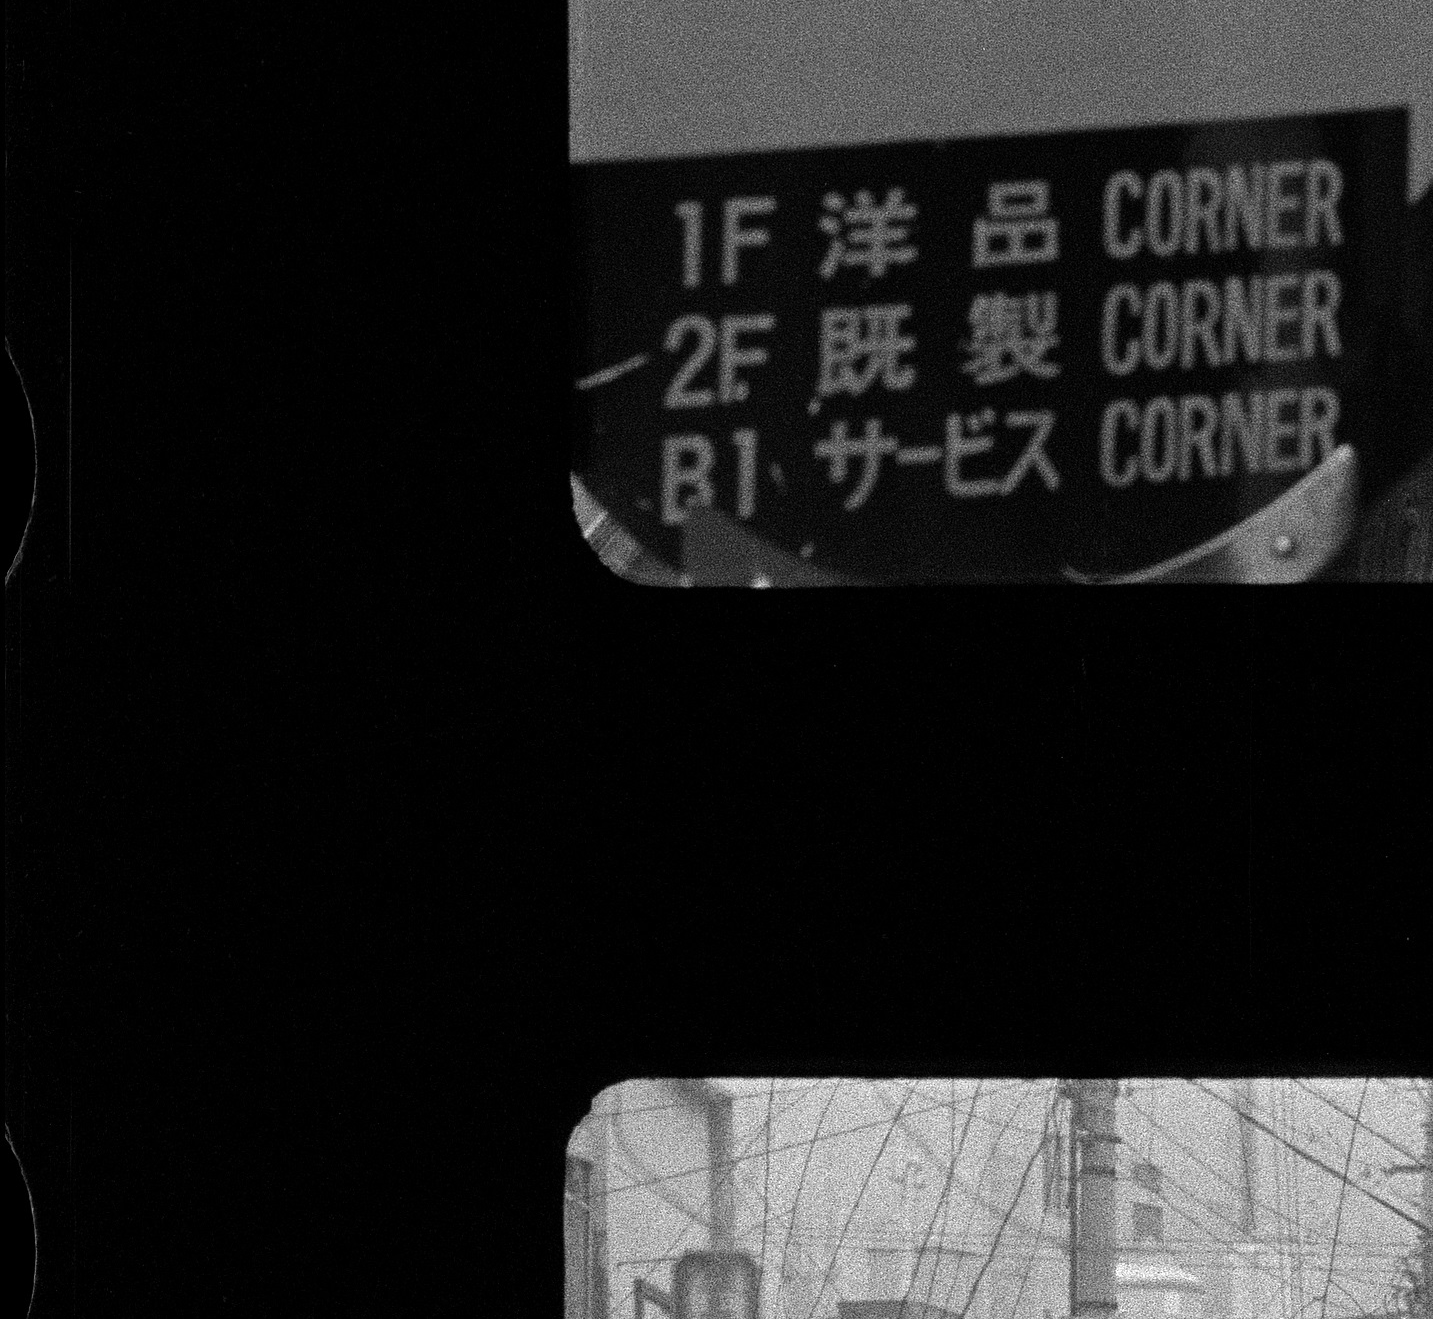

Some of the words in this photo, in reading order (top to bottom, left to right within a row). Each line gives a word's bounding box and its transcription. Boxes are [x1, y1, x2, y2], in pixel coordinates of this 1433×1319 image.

[674, 196, 778, 288] 1F
[1101, 159, 1345, 261] CORNER
[662, 312, 778, 410] 2F
[1100, 269, 1343, 376] CORNER
[660, 427, 757, 526] B1
[811, 407, 1061, 511] サービス
[1099, 387, 1342, 488] CORNER
